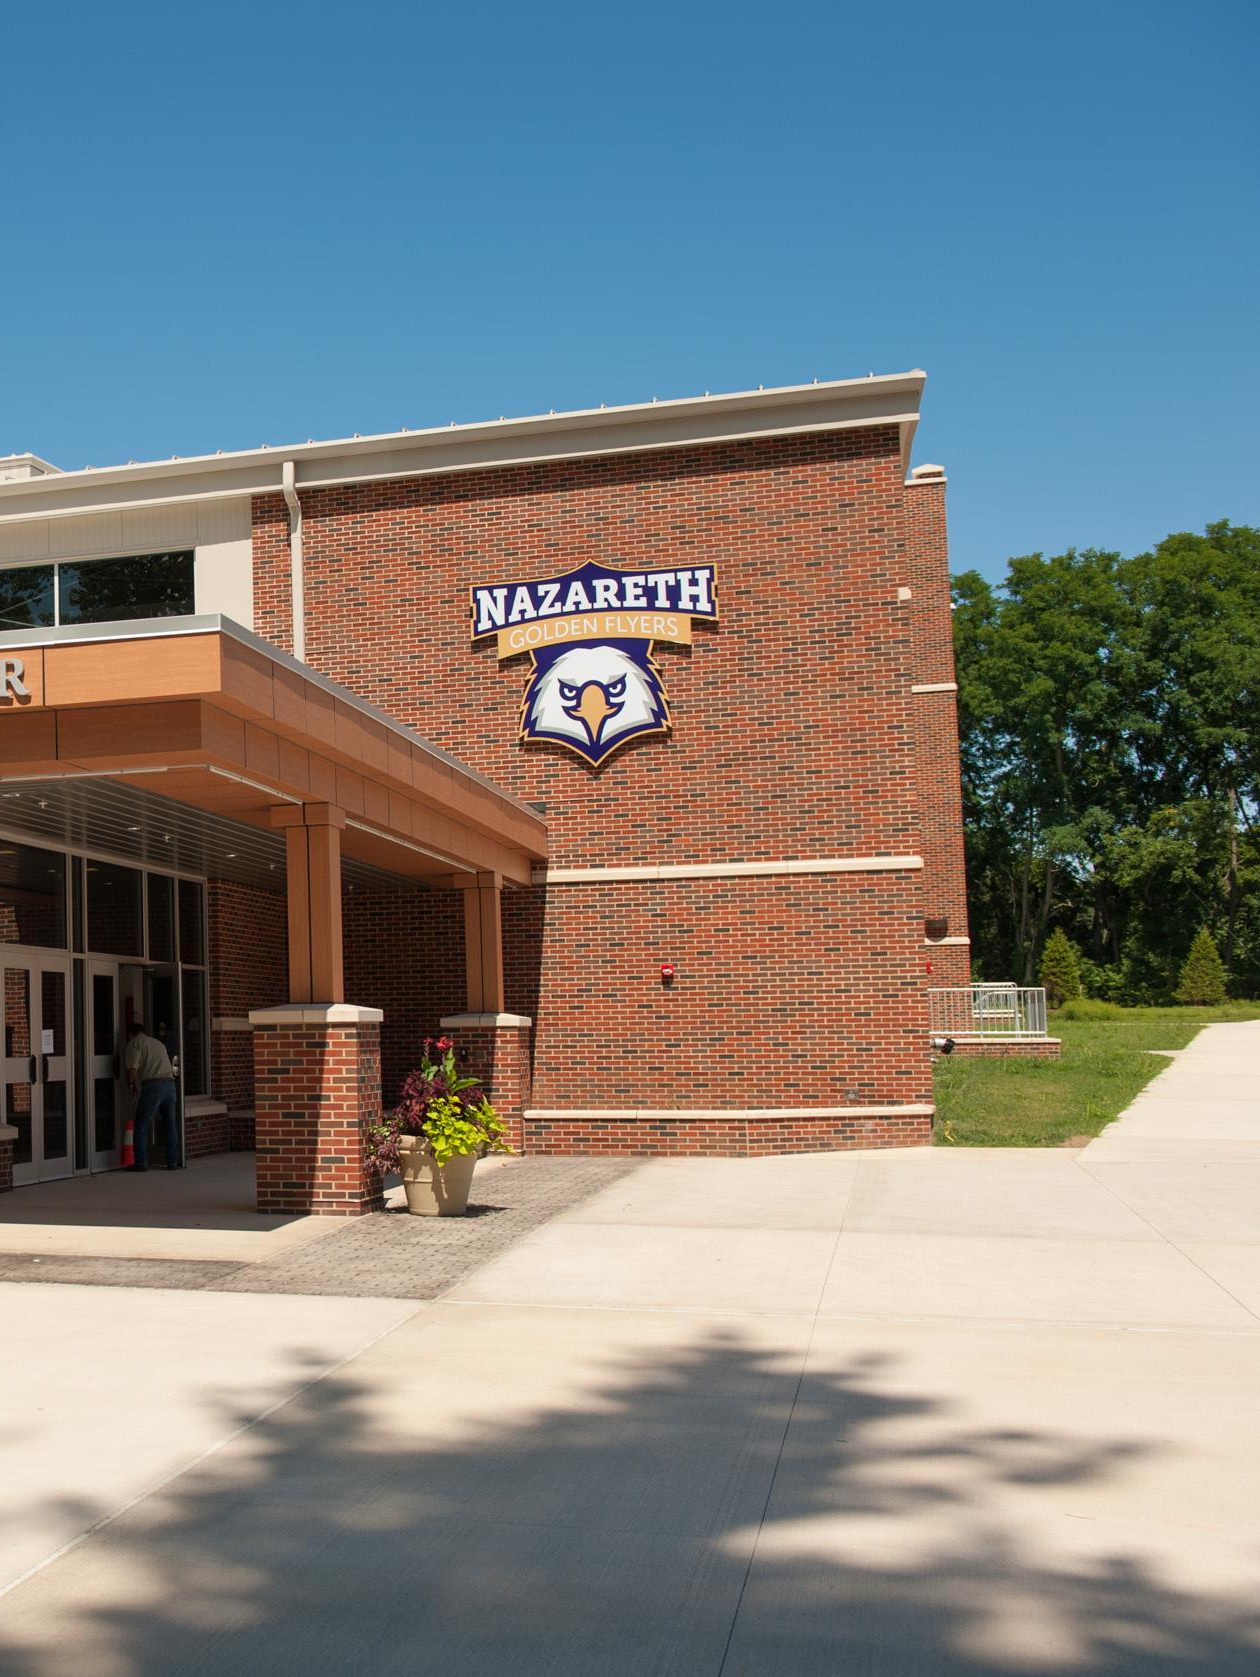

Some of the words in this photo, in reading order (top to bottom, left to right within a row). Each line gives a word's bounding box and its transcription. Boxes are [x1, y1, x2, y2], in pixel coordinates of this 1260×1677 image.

[476, 569, 712, 632] NAZARETH
[509, 617, 598, 649] GOLDEN
[605, 616, 679, 637] FLYERS
